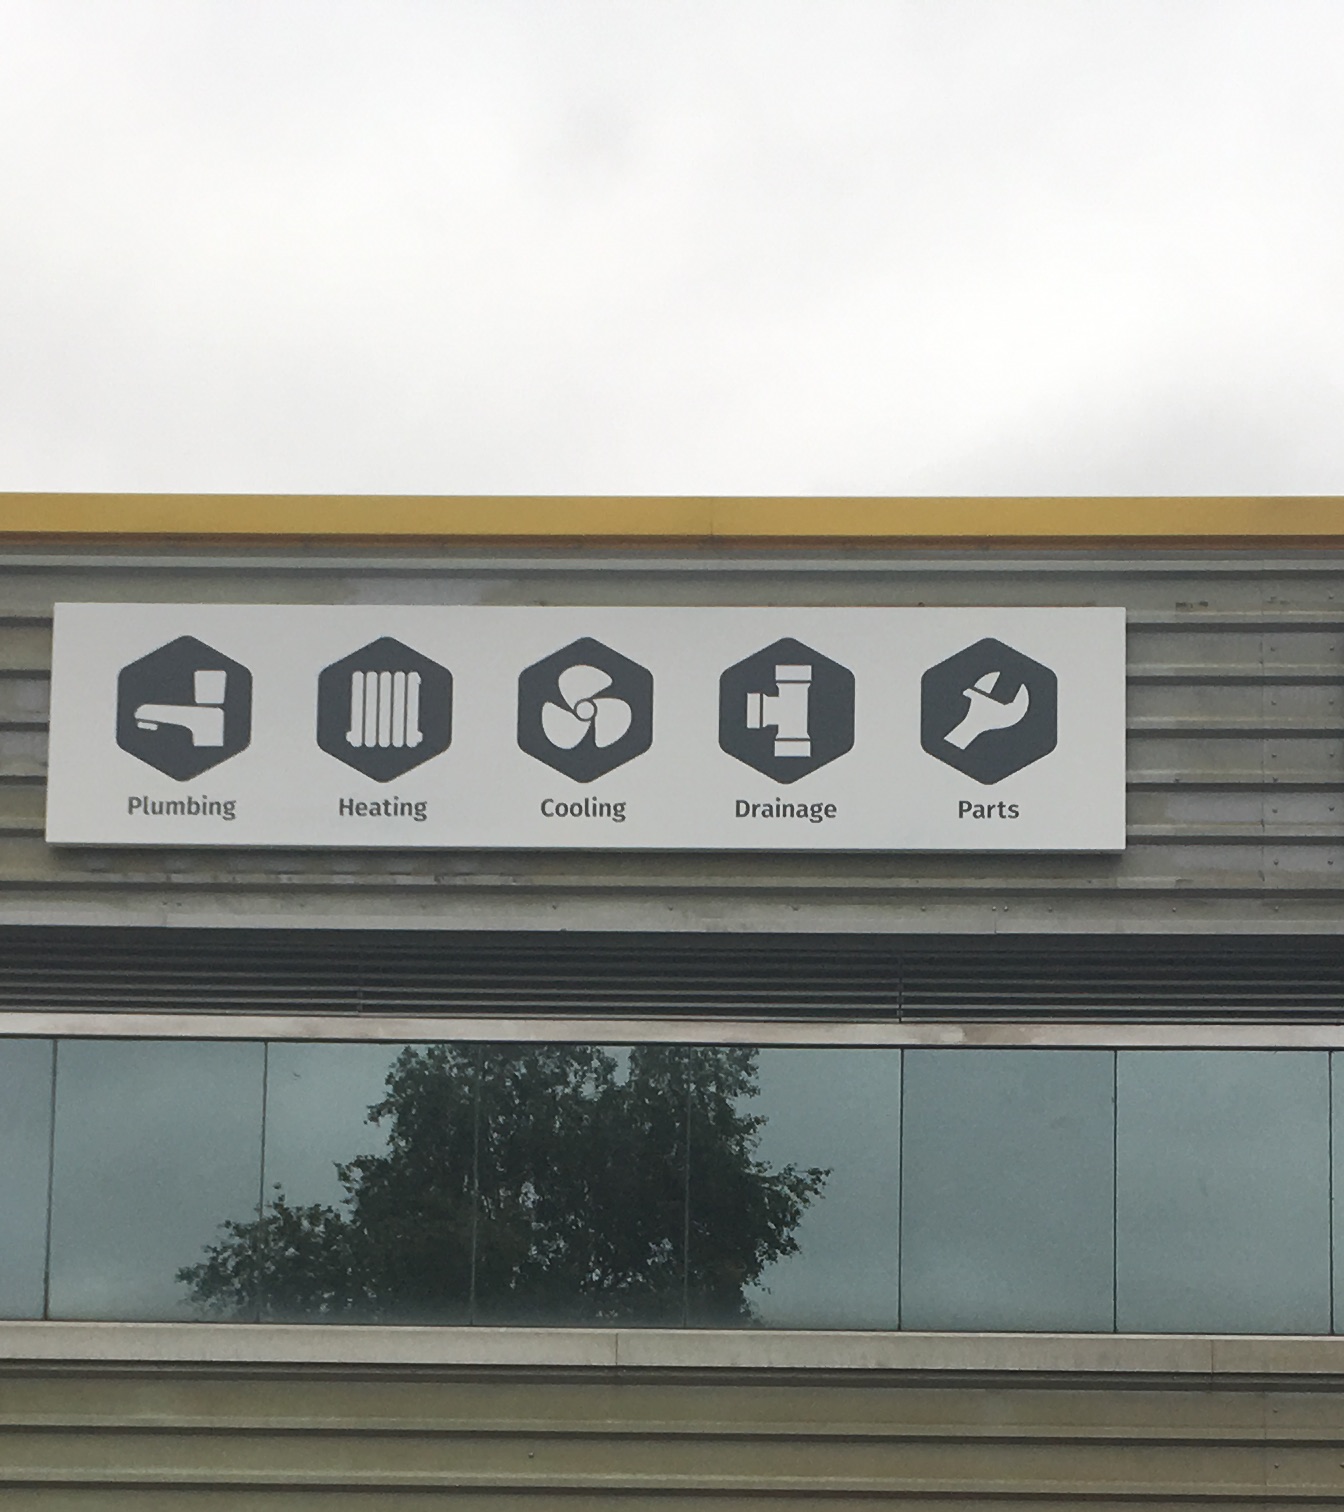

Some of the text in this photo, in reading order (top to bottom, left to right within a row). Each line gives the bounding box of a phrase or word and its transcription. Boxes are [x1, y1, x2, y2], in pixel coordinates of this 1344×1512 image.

[127, 795, 236, 822] Plumbing
[338, 796, 427, 822] Heating
[540, 796, 627, 823] Cooling
[734, 797, 837, 824] Drainage
[957, 798, 1019, 821] Parts
